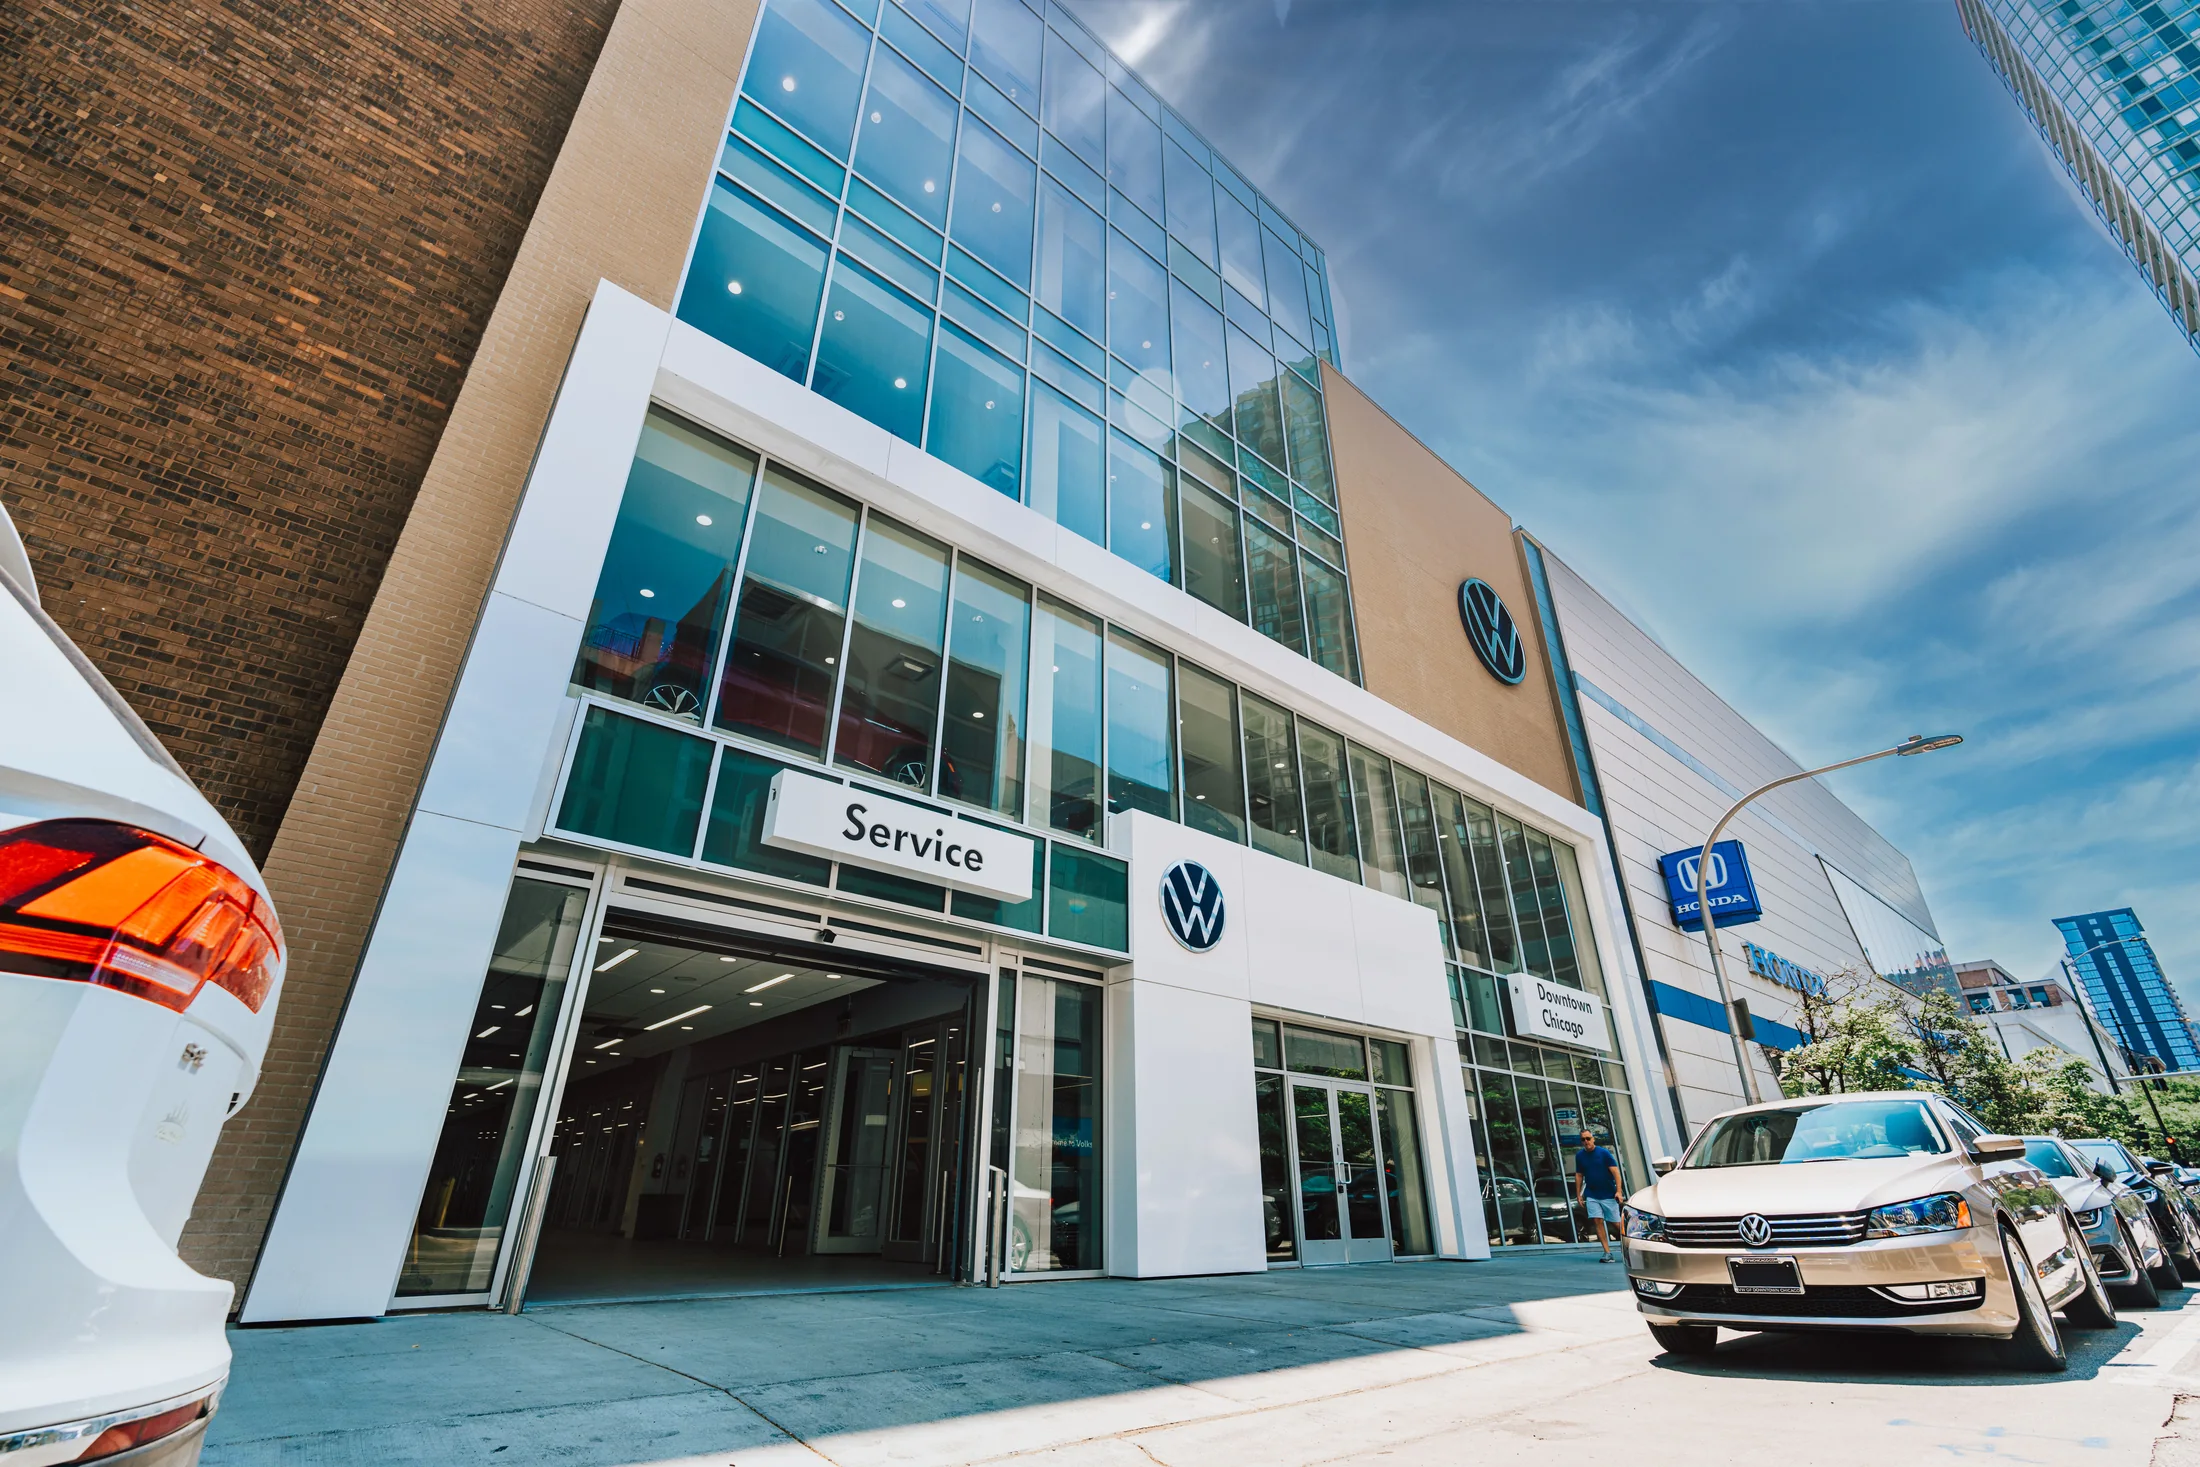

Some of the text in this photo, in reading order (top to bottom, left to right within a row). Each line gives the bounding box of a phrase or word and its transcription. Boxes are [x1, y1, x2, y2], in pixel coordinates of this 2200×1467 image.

[1464, 579, 1524, 682] VW
[842, 803, 983, 872] Service
[1161, 860, 1225, 950] VW
[1537, 983, 1592, 1014] Downtown
[1542, 1009, 1583, 1038] Chicago
[1740, 1214, 1770, 1244] VW
